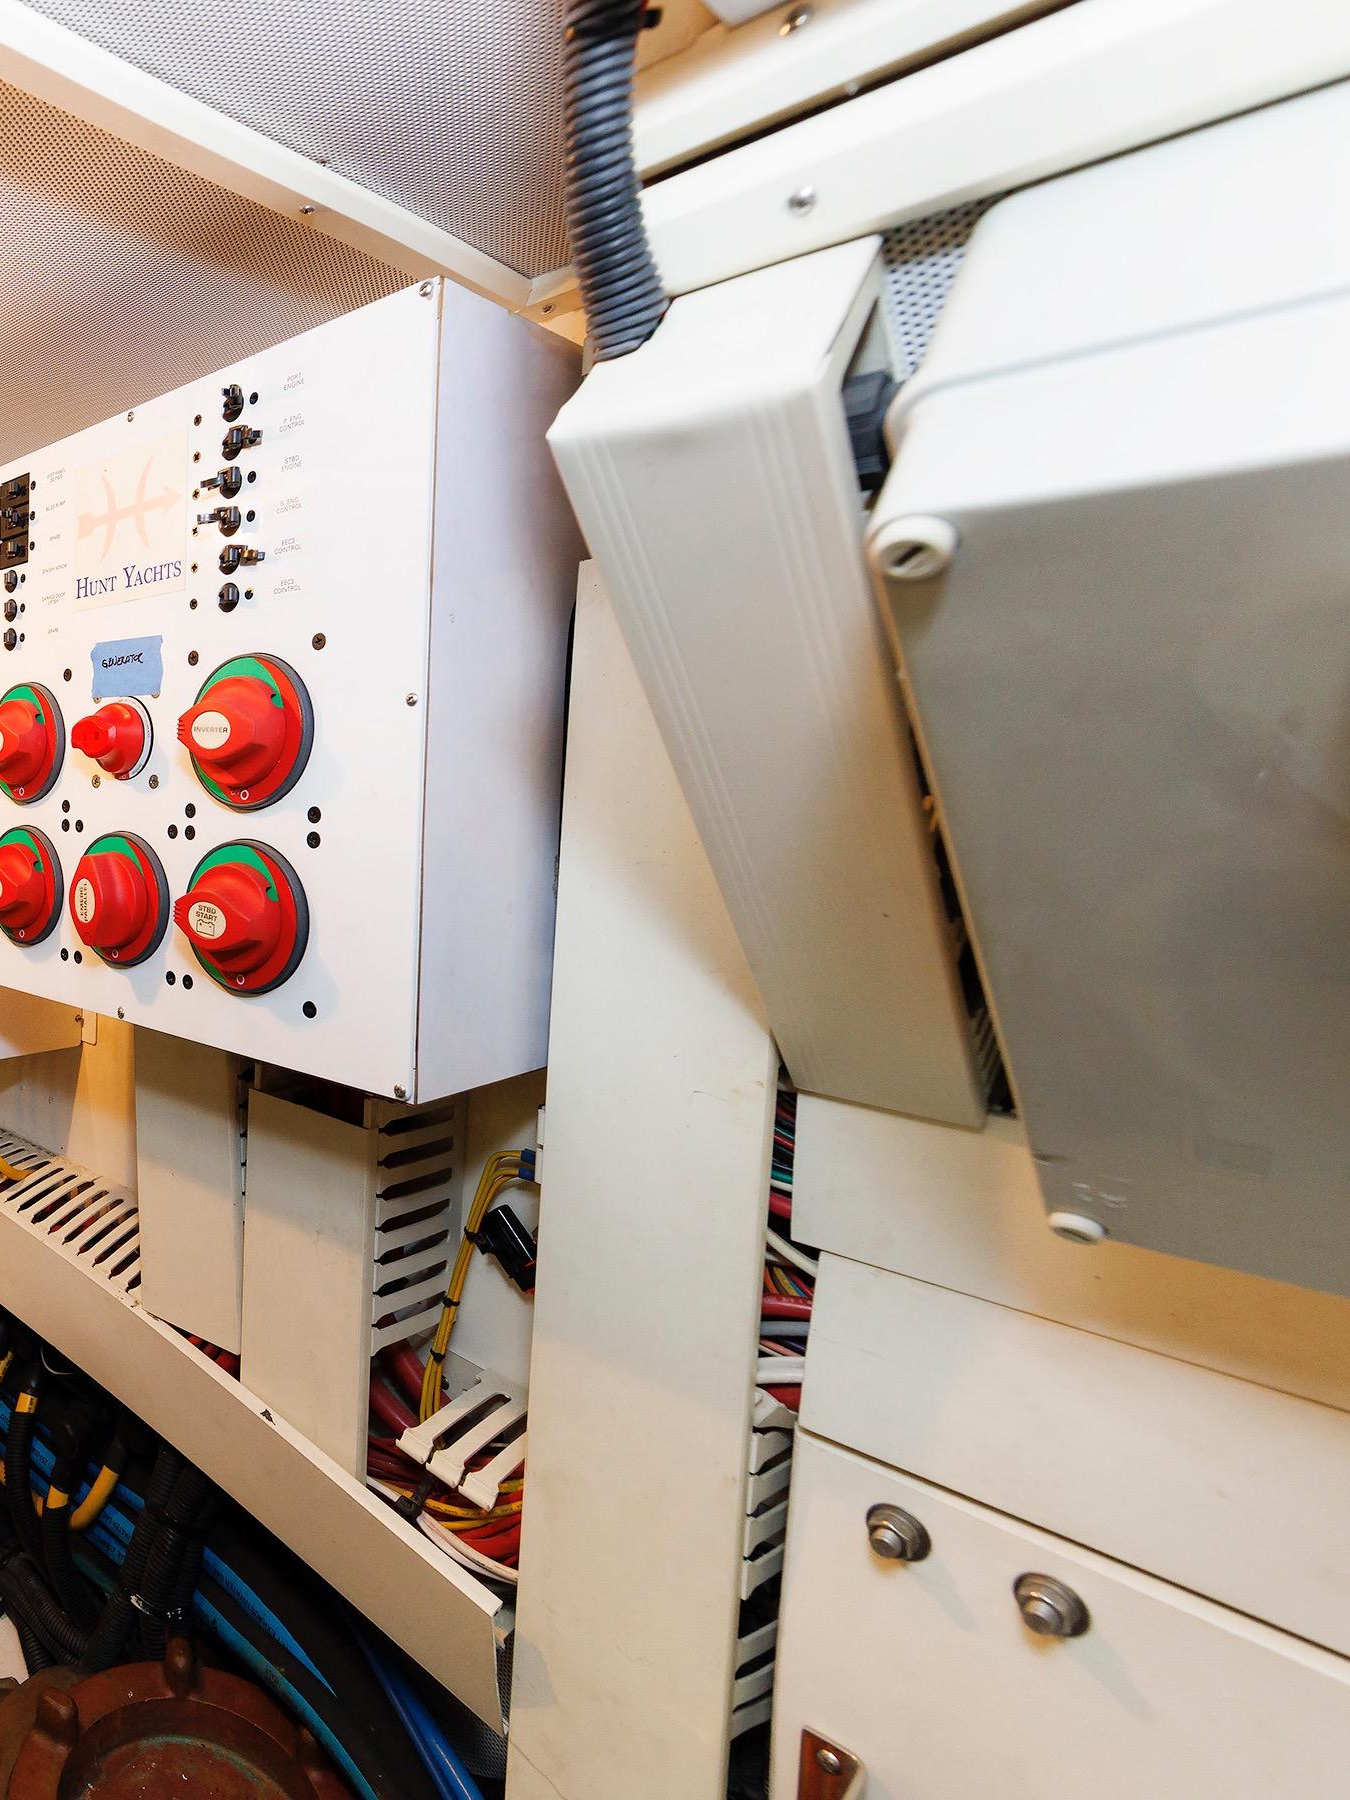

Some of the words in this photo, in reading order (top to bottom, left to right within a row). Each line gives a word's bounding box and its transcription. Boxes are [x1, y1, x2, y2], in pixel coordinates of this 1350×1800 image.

[76, 576, 117, 600] HUNT
[123, 560, 182, 589] YACHTS
[193, 726, 228, 734] INVERTER
[197, 904, 217, 915] STBD
[195, 911, 218, 922] START
